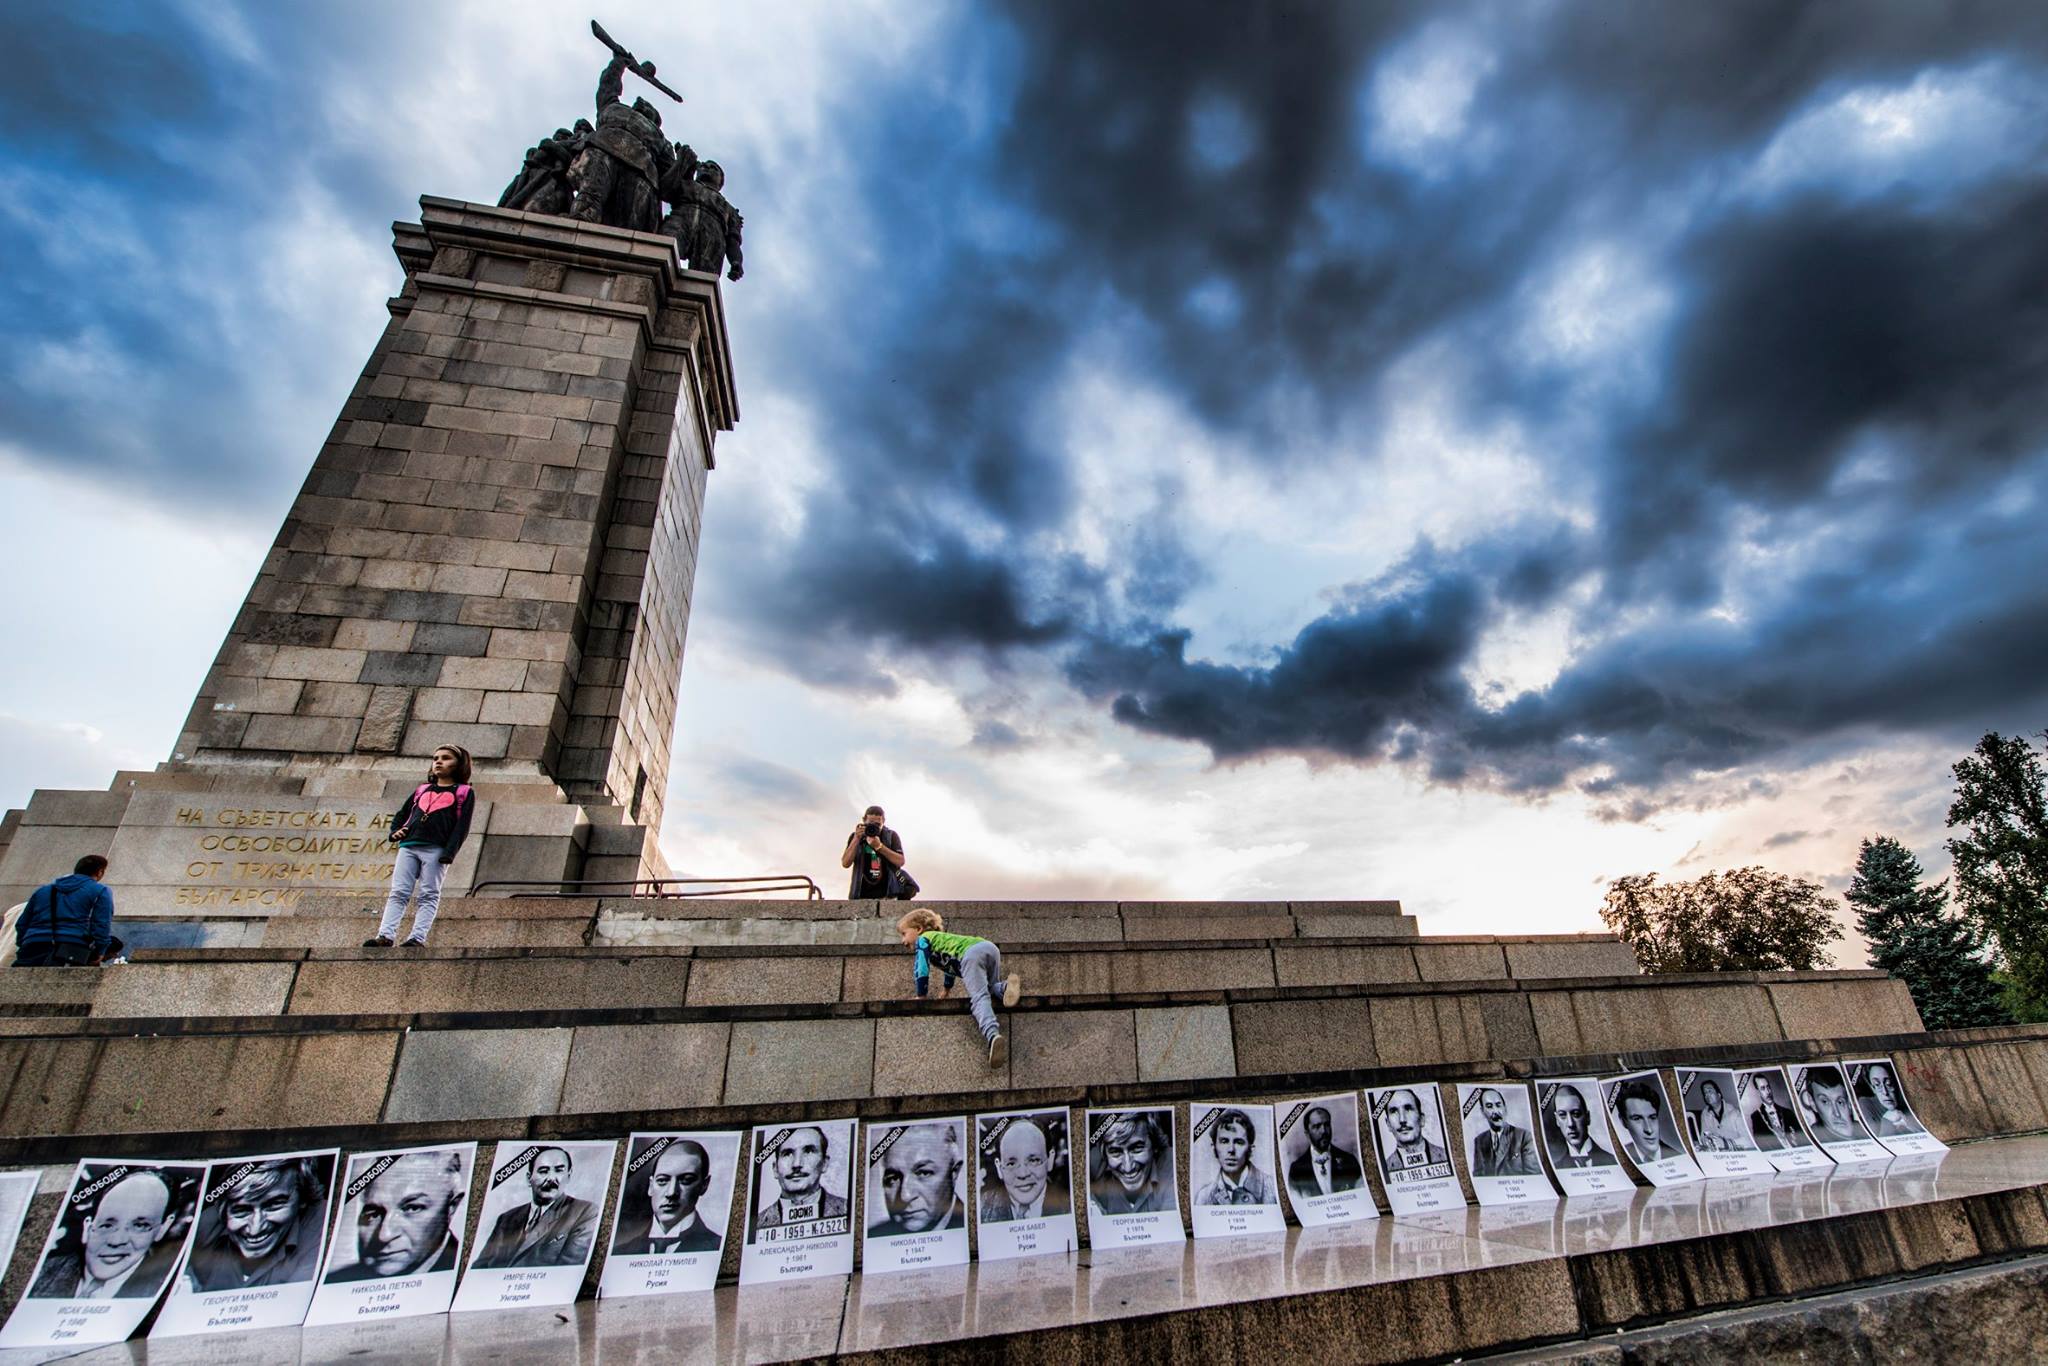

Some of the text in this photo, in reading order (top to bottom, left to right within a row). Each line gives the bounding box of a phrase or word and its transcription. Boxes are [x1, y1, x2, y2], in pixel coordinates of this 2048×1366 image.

[176, 808, 204, 825] НА
[217, 808, 358, 828] СЪВЕТСКАТА
[200, 835, 401, 854] ОСВОБОДИТЕЛКА
[186, 861, 224, 878] ОТ
[980, 1116, 1010, 1150] ОСВОБОДЕН
[754, 1128, 791, 1165] ОСВОБОДЕН
[870, 1127, 903, 1161] ОСВОБОДЕН
[629, 1137, 670, 1173] ОСВОБОДЕН
[495, 1146, 541, 1182] ОСВОБОДЕН
[205, 1162, 255, 1203] ОСВОБОДЕН
[347, 1155, 394, 1196] ОСВОБОДЕН
[71, 1165, 129, 1204] ОСВОБОДЕН
[788, 1205, 814, 1221] СОФИЯ
[1009, 1224, 1025, 1232] ИСАК
[759, 1243, 805, 1256] АЛЕКСАНДЪР
[890, 1238, 917, 1247] НИКОЛА
[629, 1257, 698, 1268] НИКОЛАЙ ГУМИЛЕВ
[780, 1264, 813, 1275] България
[503, 1271, 548, 1281] ИМРЕ НАГИ
[645, 1279, 669, 1289] Русия
[351, 1279, 423, 1294] НИКОЛА ПЕТКОВ
[202, 1291, 280, 1306] ГЕОРГИ МАРКОВ
[358, 1303, 401, 1315] България
[207, 1315, 253, 1327] България
